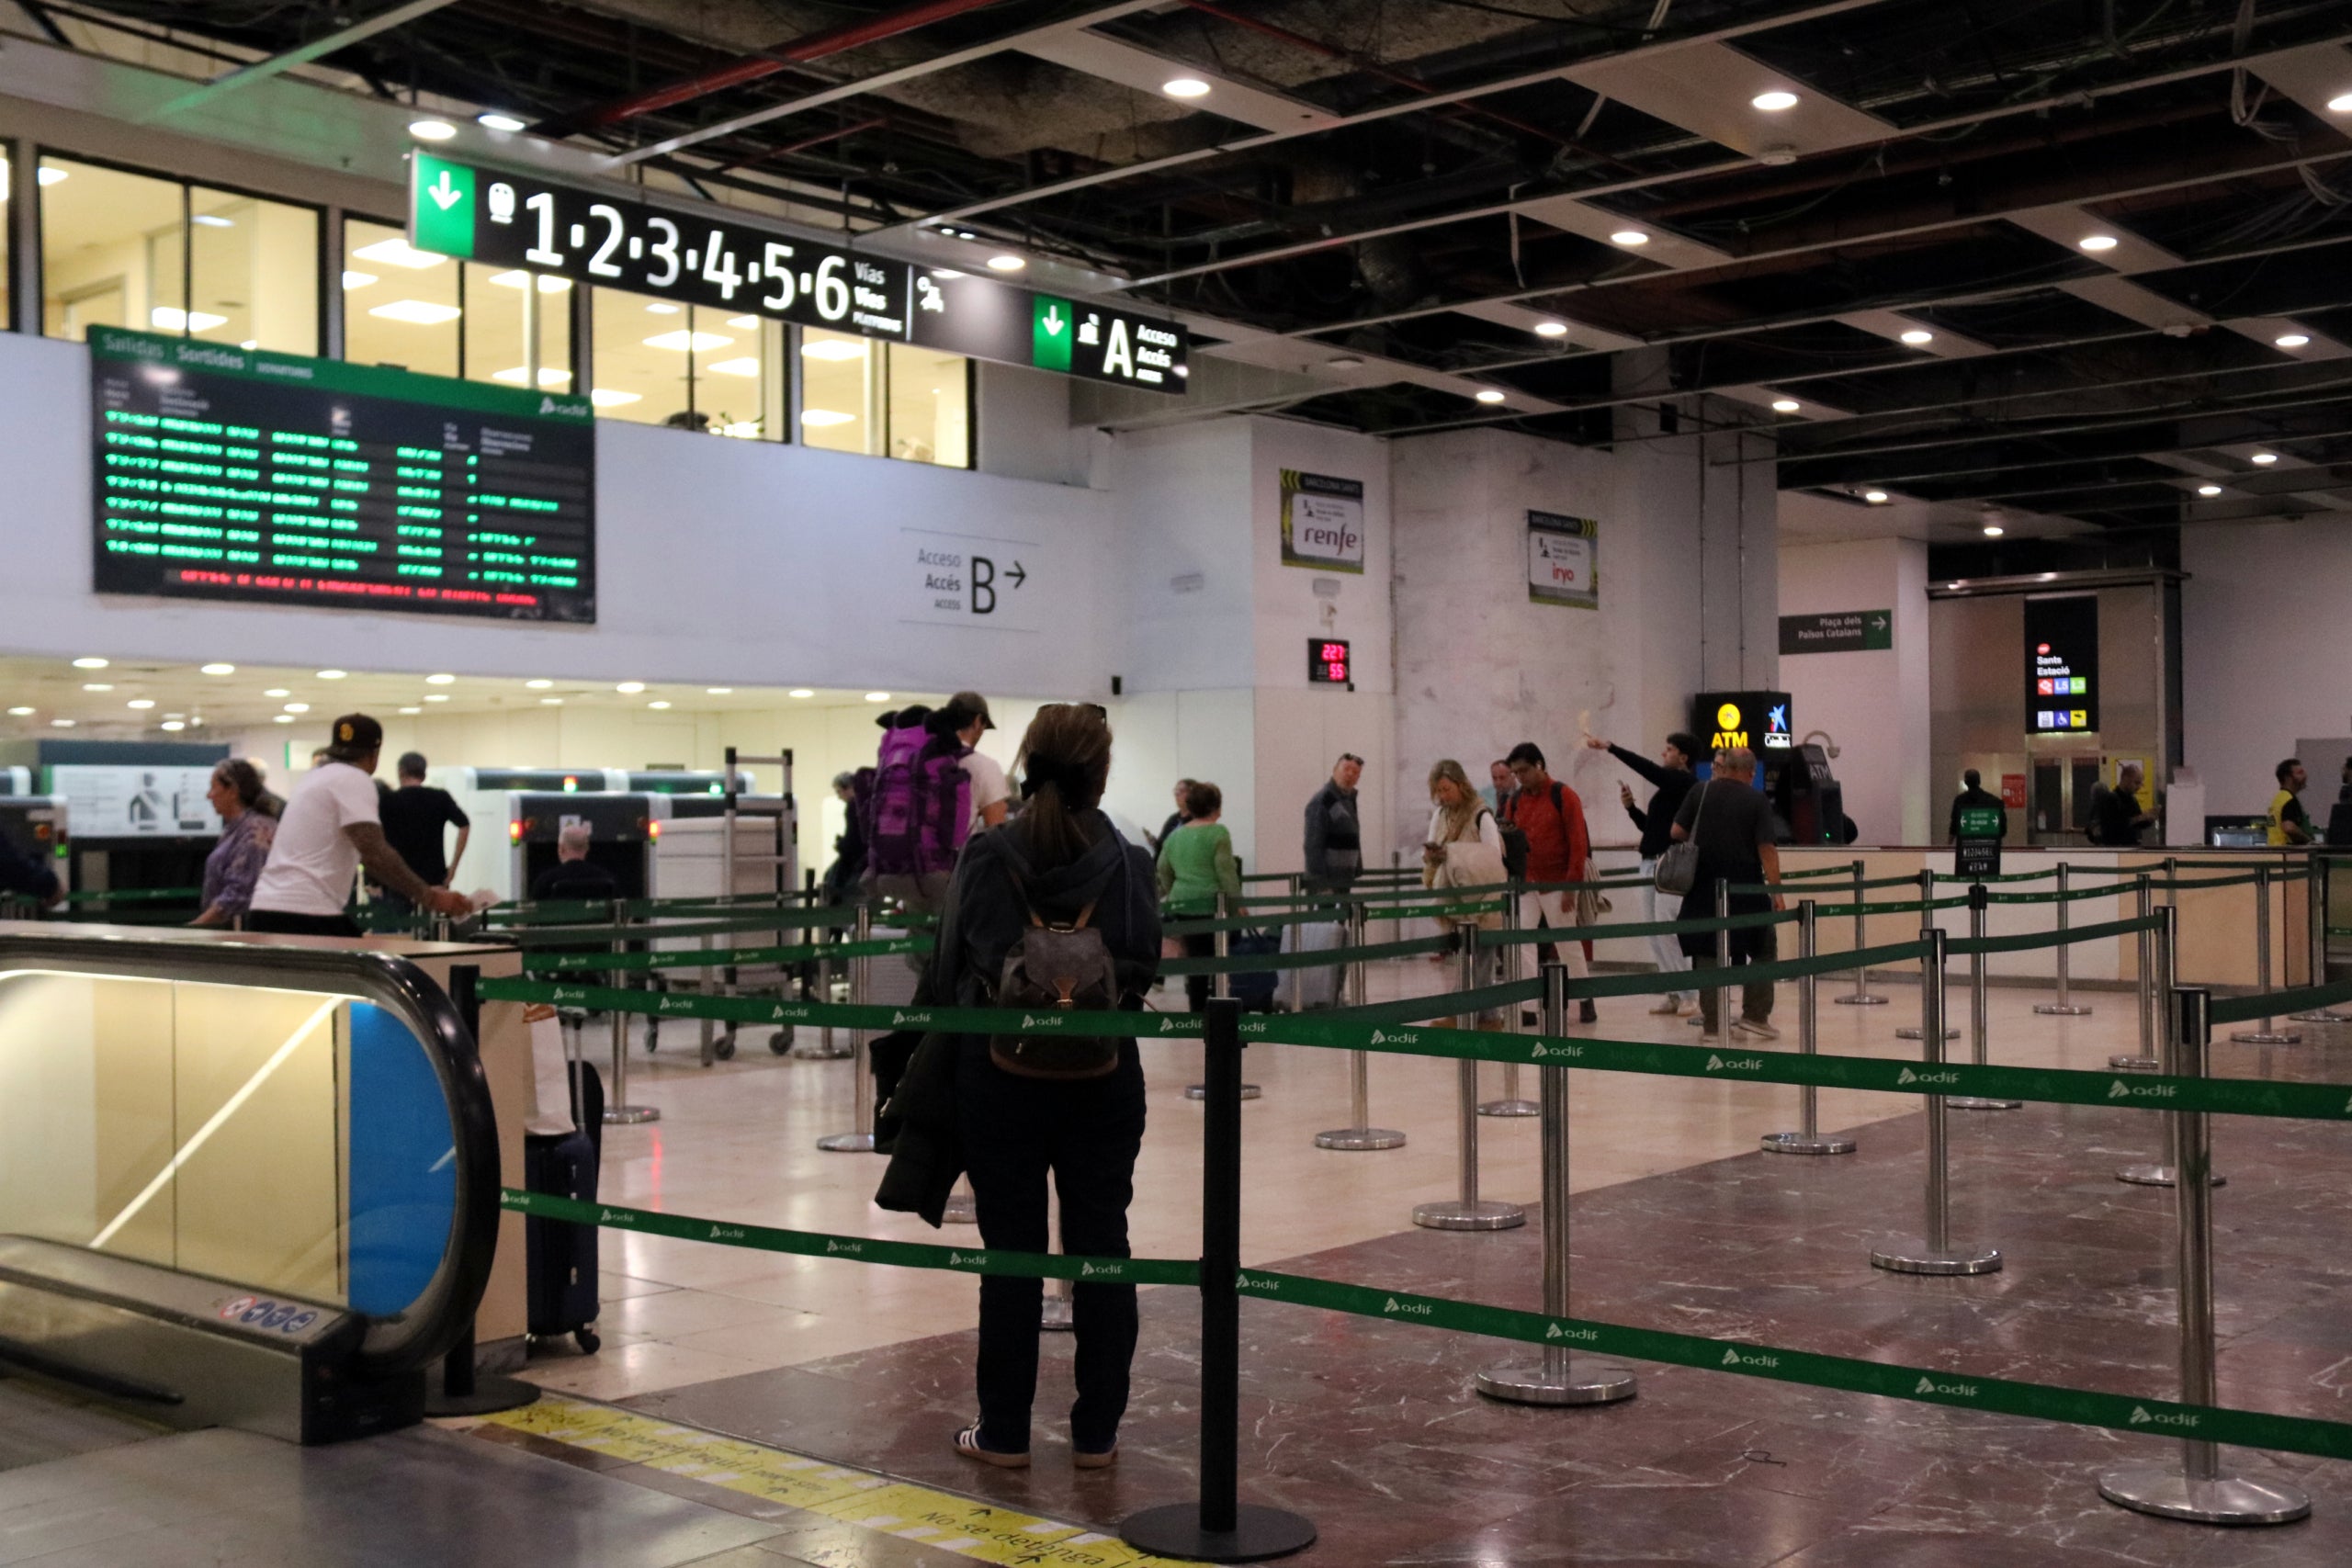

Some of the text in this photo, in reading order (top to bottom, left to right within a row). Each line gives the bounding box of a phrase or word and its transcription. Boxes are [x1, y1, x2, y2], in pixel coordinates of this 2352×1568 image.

[854, 261, 885, 286] Vías
[1136, 323, 1178, 348] Acceso
[102, 333, 164, 359] Salidas
[176, 344, 245, 369] Sortides
[1102, 318, 1134, 378] A
[1136, 345, 1171, 367] Accés
[1305, 523, 1357, 556] renfe
[918, 547, 961, 568] Acceso
[925, 573, 961, 592] Accés
[971, 555, 996, 614] B
[934, 599, 961, 611] ACCESS
[1819, 615, 1862, 628] Plaça dels
[1826, 627, 1862, 638] Catalans
[2037, 656, 2063, 666] Sants
[1329, 663, 1346, 681] 55
[2037, 666, 2070, 676] Estació
[2056, 681, 2069, 690] L5
[1711, 731, 1748, 749] ATM
[564, 990, 586, 998] adif
[672, 1000, 694, 1009] adif
[784, 1009, 808, 1017] adif
[906, 1013, 933, 1022] adif
[1036, 1016, 1063, 1026] adif
[1175, 1019, 1204, 1029] adif
[1238, 1022, 1266, 1032] adif
[1387, 1033, 1419, 1044] adif
[1550, 1045, 1584, 1057] adif
[1726, 1058, 1763, 1071] adif
[1919, 1071, 1960, 1084] adif
[2132, 1084, 2177, 1098] adif
[510, 1195, 530, 1205] adif
[613, 1213, 635, 1223] adif
[722, 1229, 745, 1239] adif
[840, 1243, 862, 1253] adif
[964, 1255, 988, 1265] adif
[1095, 1265, 1124, 1275] adif
[1251, 1280, 1280, 1291] adif
[1401, 1303, 1433, 1315] adif
[1565, 1328, 1599, 1341] adif
[1742, 1355, 1780, 1368] adif
[1937, 1382, 1978, 1397] adif
[2154, 1412, 2200, 1427] adif
[920, 1512, 1105, 1565] No se detenga
